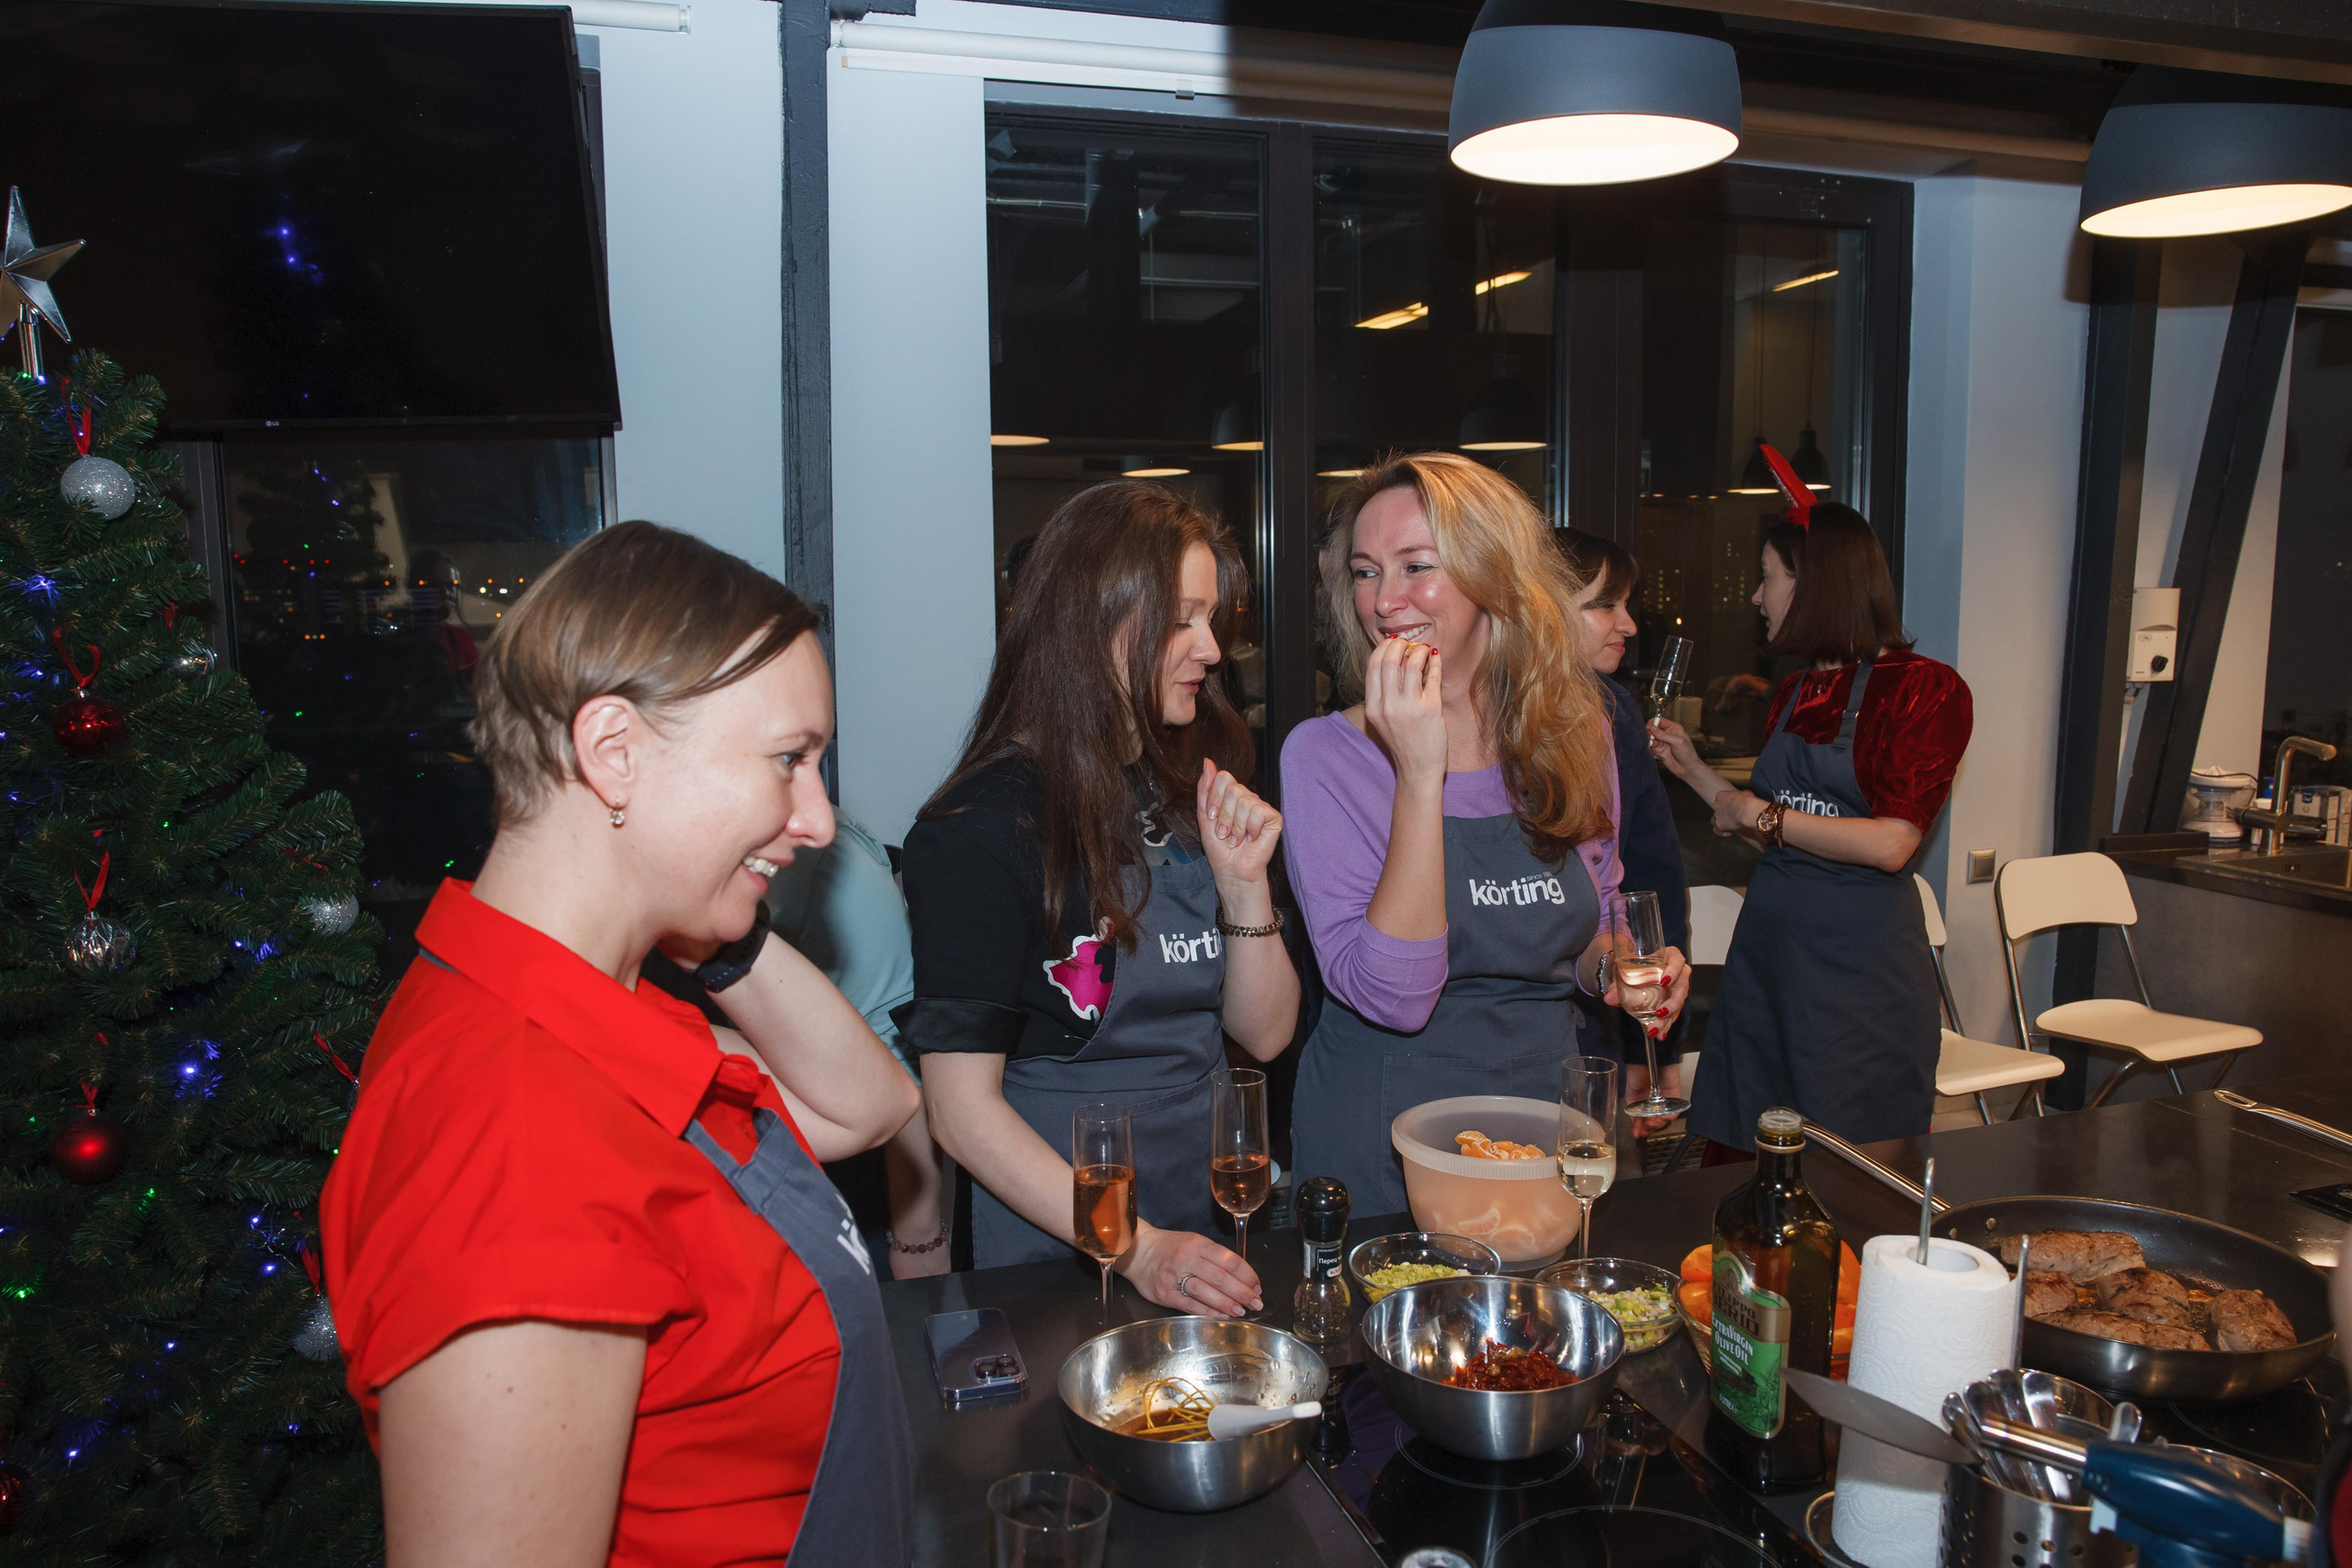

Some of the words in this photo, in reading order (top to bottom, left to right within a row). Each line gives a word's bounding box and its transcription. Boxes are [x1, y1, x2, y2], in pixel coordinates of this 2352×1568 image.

[1469, 877, 1566, 906] körting
[1714, 1330, 1736, 1355] OLIVE
[1735, 1345, 1749, 1366] OIL
